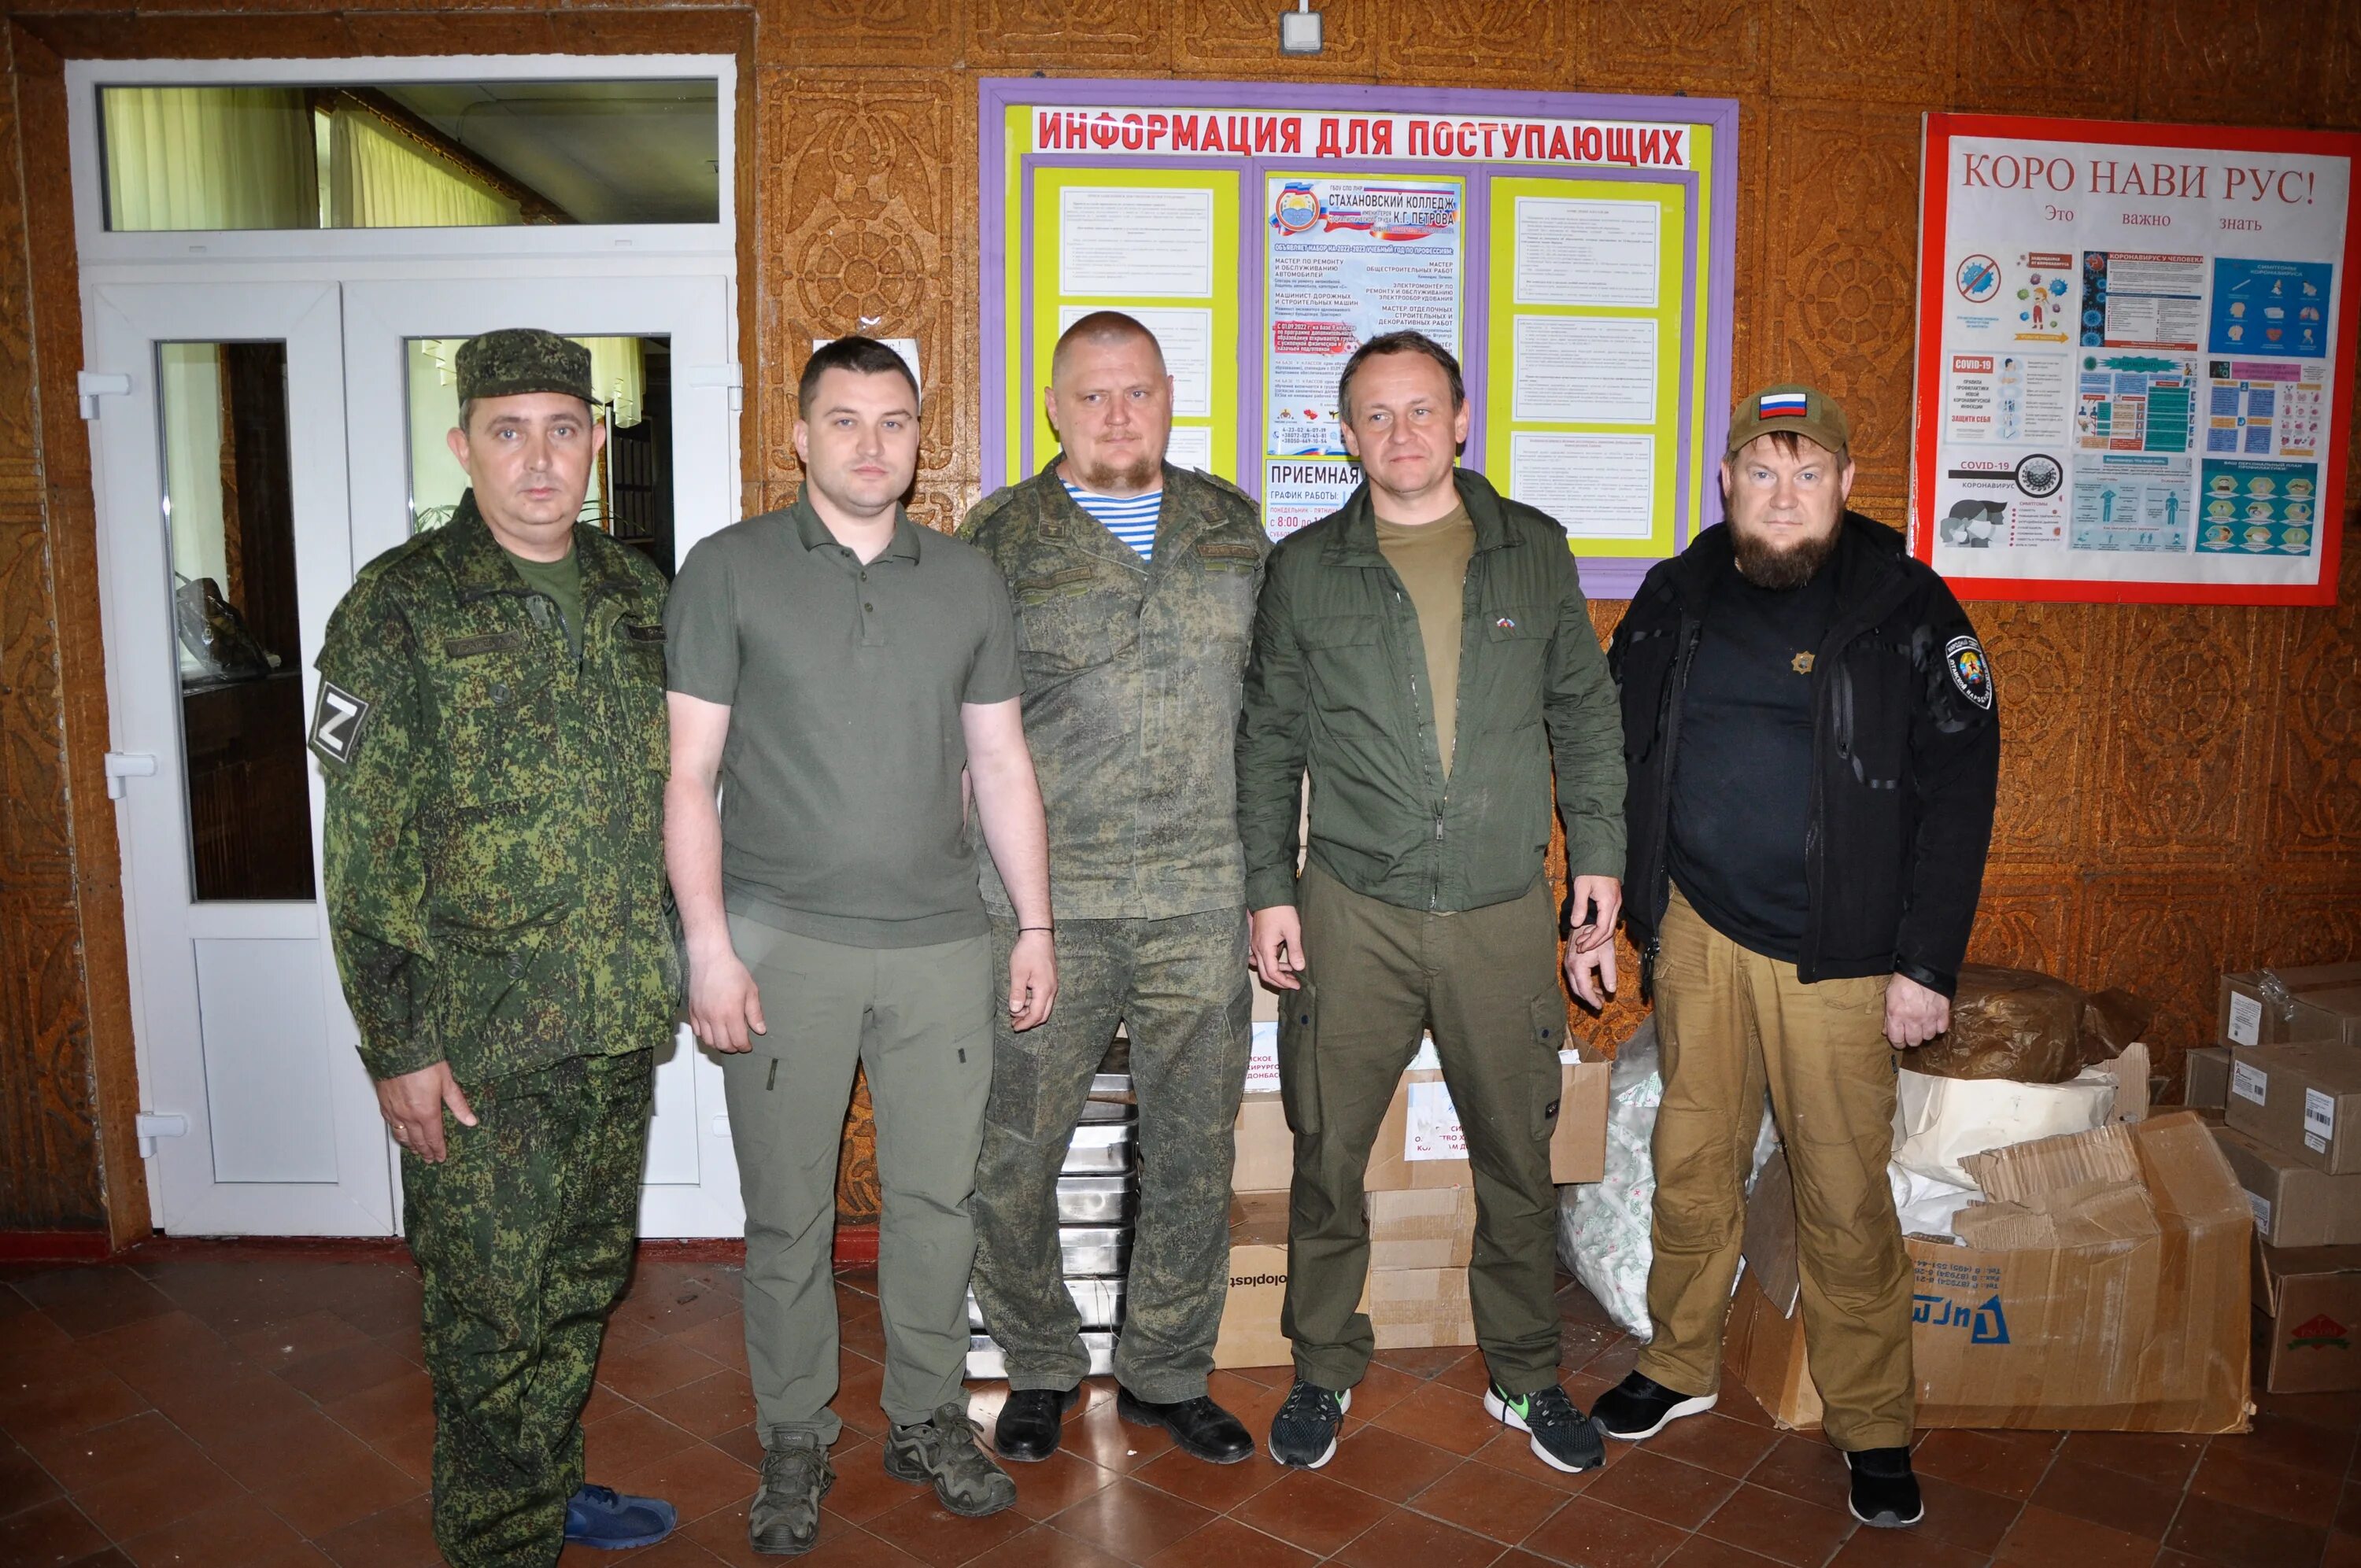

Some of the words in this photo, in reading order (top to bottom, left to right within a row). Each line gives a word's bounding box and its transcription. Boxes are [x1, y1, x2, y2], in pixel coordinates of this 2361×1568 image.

[1039, 112, 1302, 156] ИНФОРМАЦИЯ
[1316, 118, 1392, 157] ДЛЯ
[1409, 120, 1683, 167] ПОСТУПАЮЩИХ
[1962, 153, 2075, 191] КОРО
[2088, 160, 2208, 198] НАВИ
[2222, 167, 2315, 205] РУС!
[1329, 193, 1403, 208] СТАХАНОВСКИЙ
[1406, 196, 1454, 209] КОЛЛЕДЖ
[1394, 212, 1409, 223] К.Г.
[1412, 212, 1454, 224] ПЕТРОВА
[2045, 205, 2074, 222] Это
[2123, 213, 2171, 227] важно
[2219, 217, 2262, 231] знать
[1367, 245, 1393, 254] УЧЕБНЫЙ
[1956, 360, 1991, 370] COVID-19
[1960, 461, 2009, 470] COVID-19
[1271, 466, 1359, 484] ПРИЕМНАЯ
[1270, 491, 1302, 500] ГРАФИК
[1277, 516, 1298, 527] 8:00
[318, 692, 357, 751] Z
[1230, 1274, 1288, 1287] oloplast
